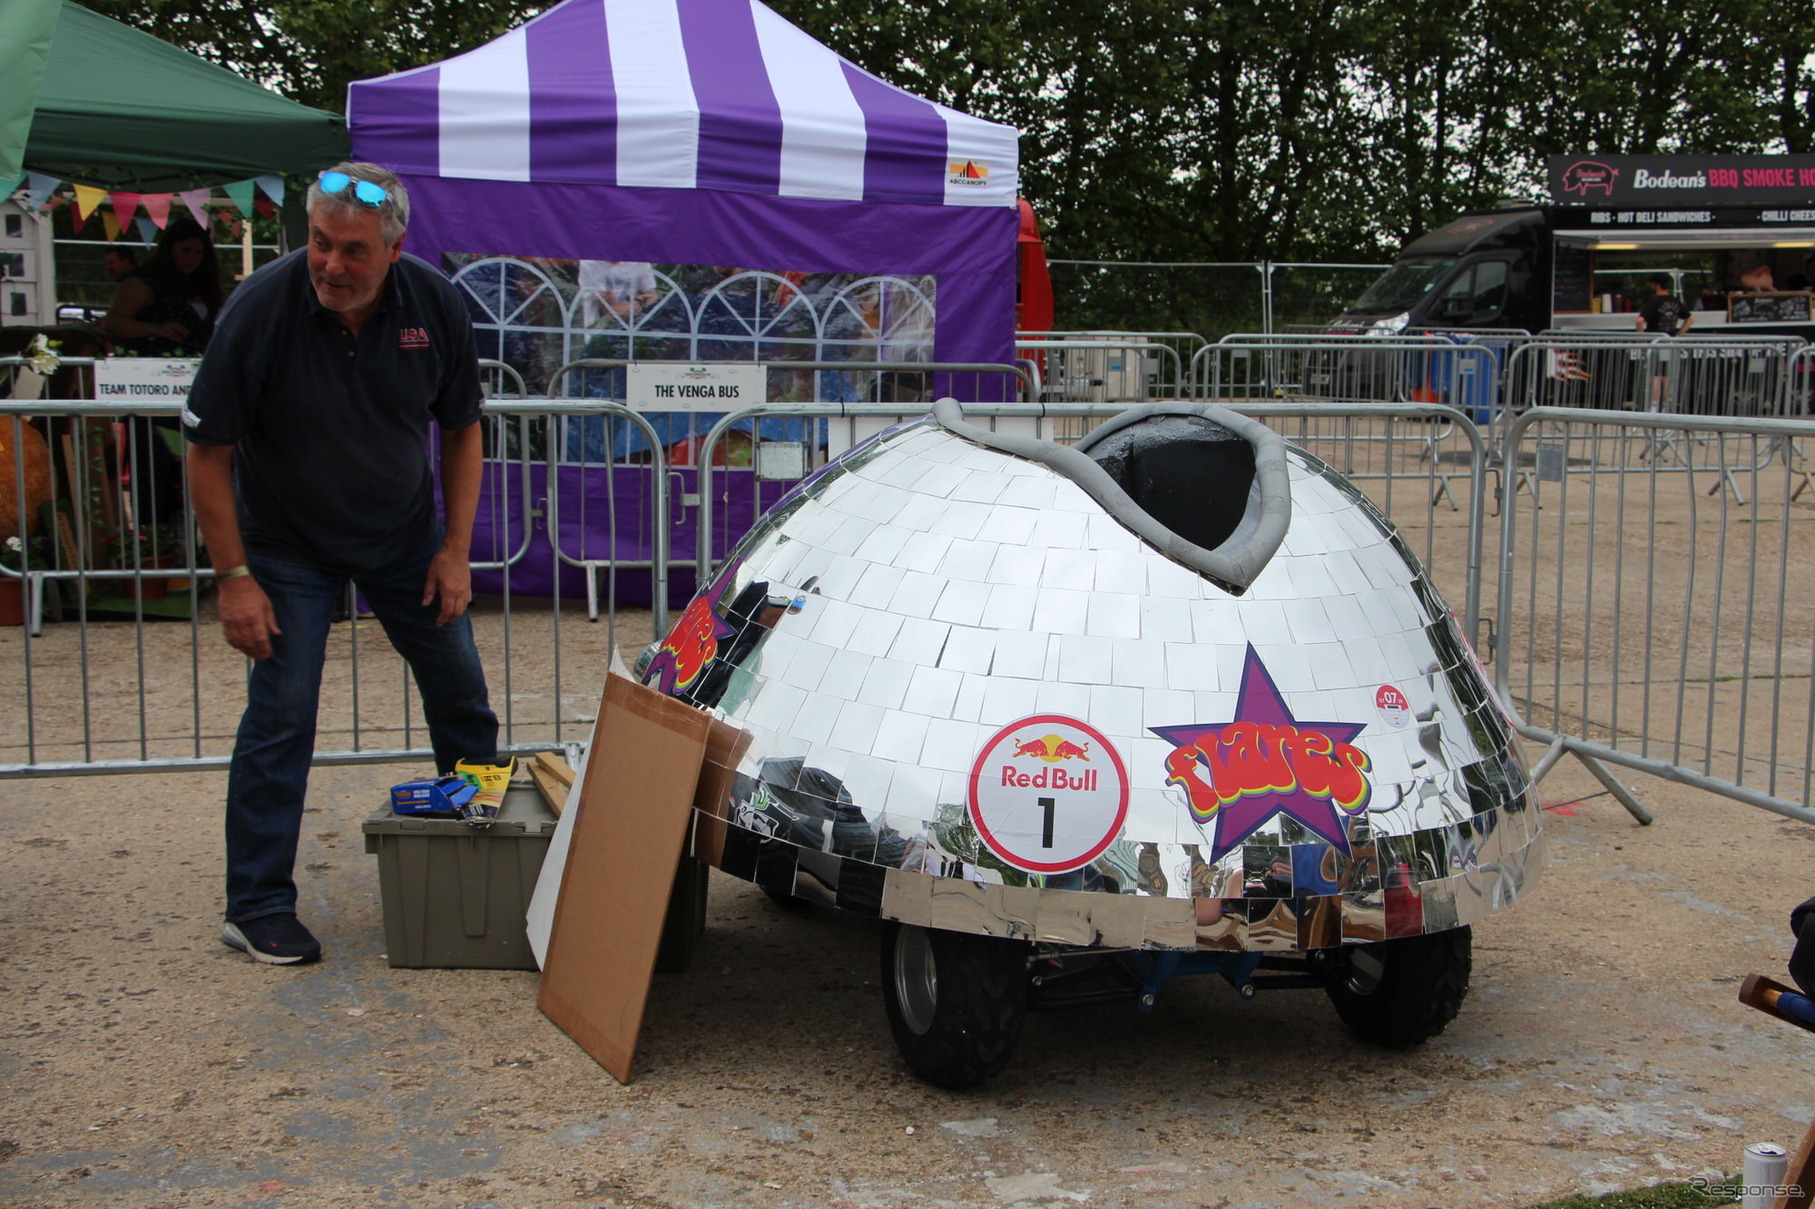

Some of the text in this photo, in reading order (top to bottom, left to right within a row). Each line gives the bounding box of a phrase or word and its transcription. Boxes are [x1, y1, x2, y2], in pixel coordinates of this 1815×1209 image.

[1633, 168, 1706, 188] Bodean's
[1708, 168, 1739, 188] BBQ
[1743, 168, 1796, 187] SMOKE
[1590, 210, 1711, 223] RIBS HOT DELI SANDWICHES
[99, 383, 126, 395] TEAM
[129, 384, 169, 395] TOTORO
[655, 385, 739, 398] THE VENGA BUS
[1384, 692, 1396, 703] 07
[1001, 765, 1097, 791] Red Bull
[1038, 797, 1055, 848] 1
